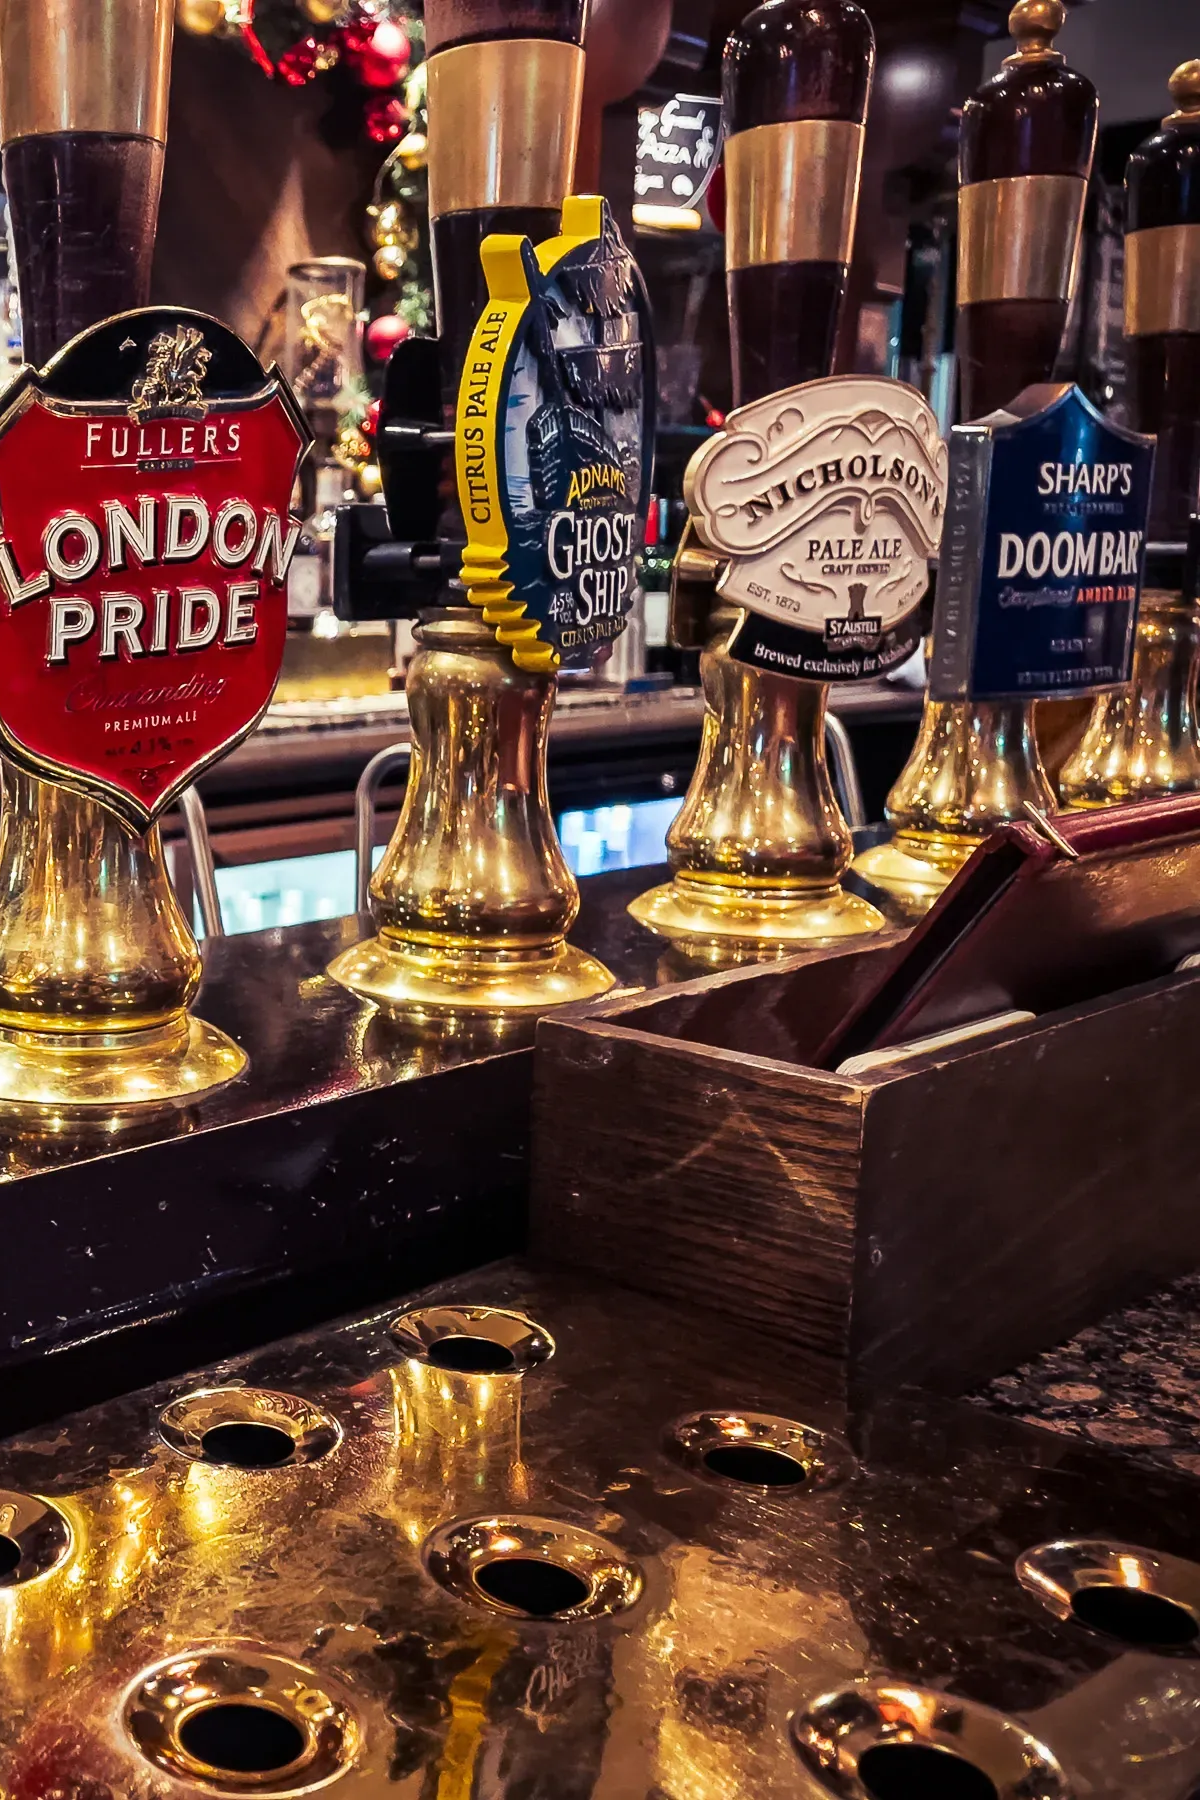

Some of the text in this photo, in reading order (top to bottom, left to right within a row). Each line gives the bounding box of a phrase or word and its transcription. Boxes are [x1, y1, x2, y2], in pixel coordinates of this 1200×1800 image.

[463, 311, 508, 525] CITRUS PALE ALE
[85, 421, 241, 458] FULLER'S
[565, 463, 627, 508] ADNAMS
[746, 454, 941, 528] NICHOLSON'S
[1037, 462, 1133, 495] SHARP'S
[548, 510, 636, 580] GHOST
[805, 538, 903, 562] PALE ALE
[997, 530, 1140, 579] DOOM BAR
[821, 563, 854, 576] CRAFT
[575, 565, 629, 626] SHIP
[746, 581, 801, 613] EST. 1873
[1076, 586, 1114, 603] AMBER
[45, 580, 261, 665] PRIDE
[754, 641, 802, 669] Brewed
[803, 655, 862, 677] exclusively
[104, 710, 198, 733] PREMIUM ALE
